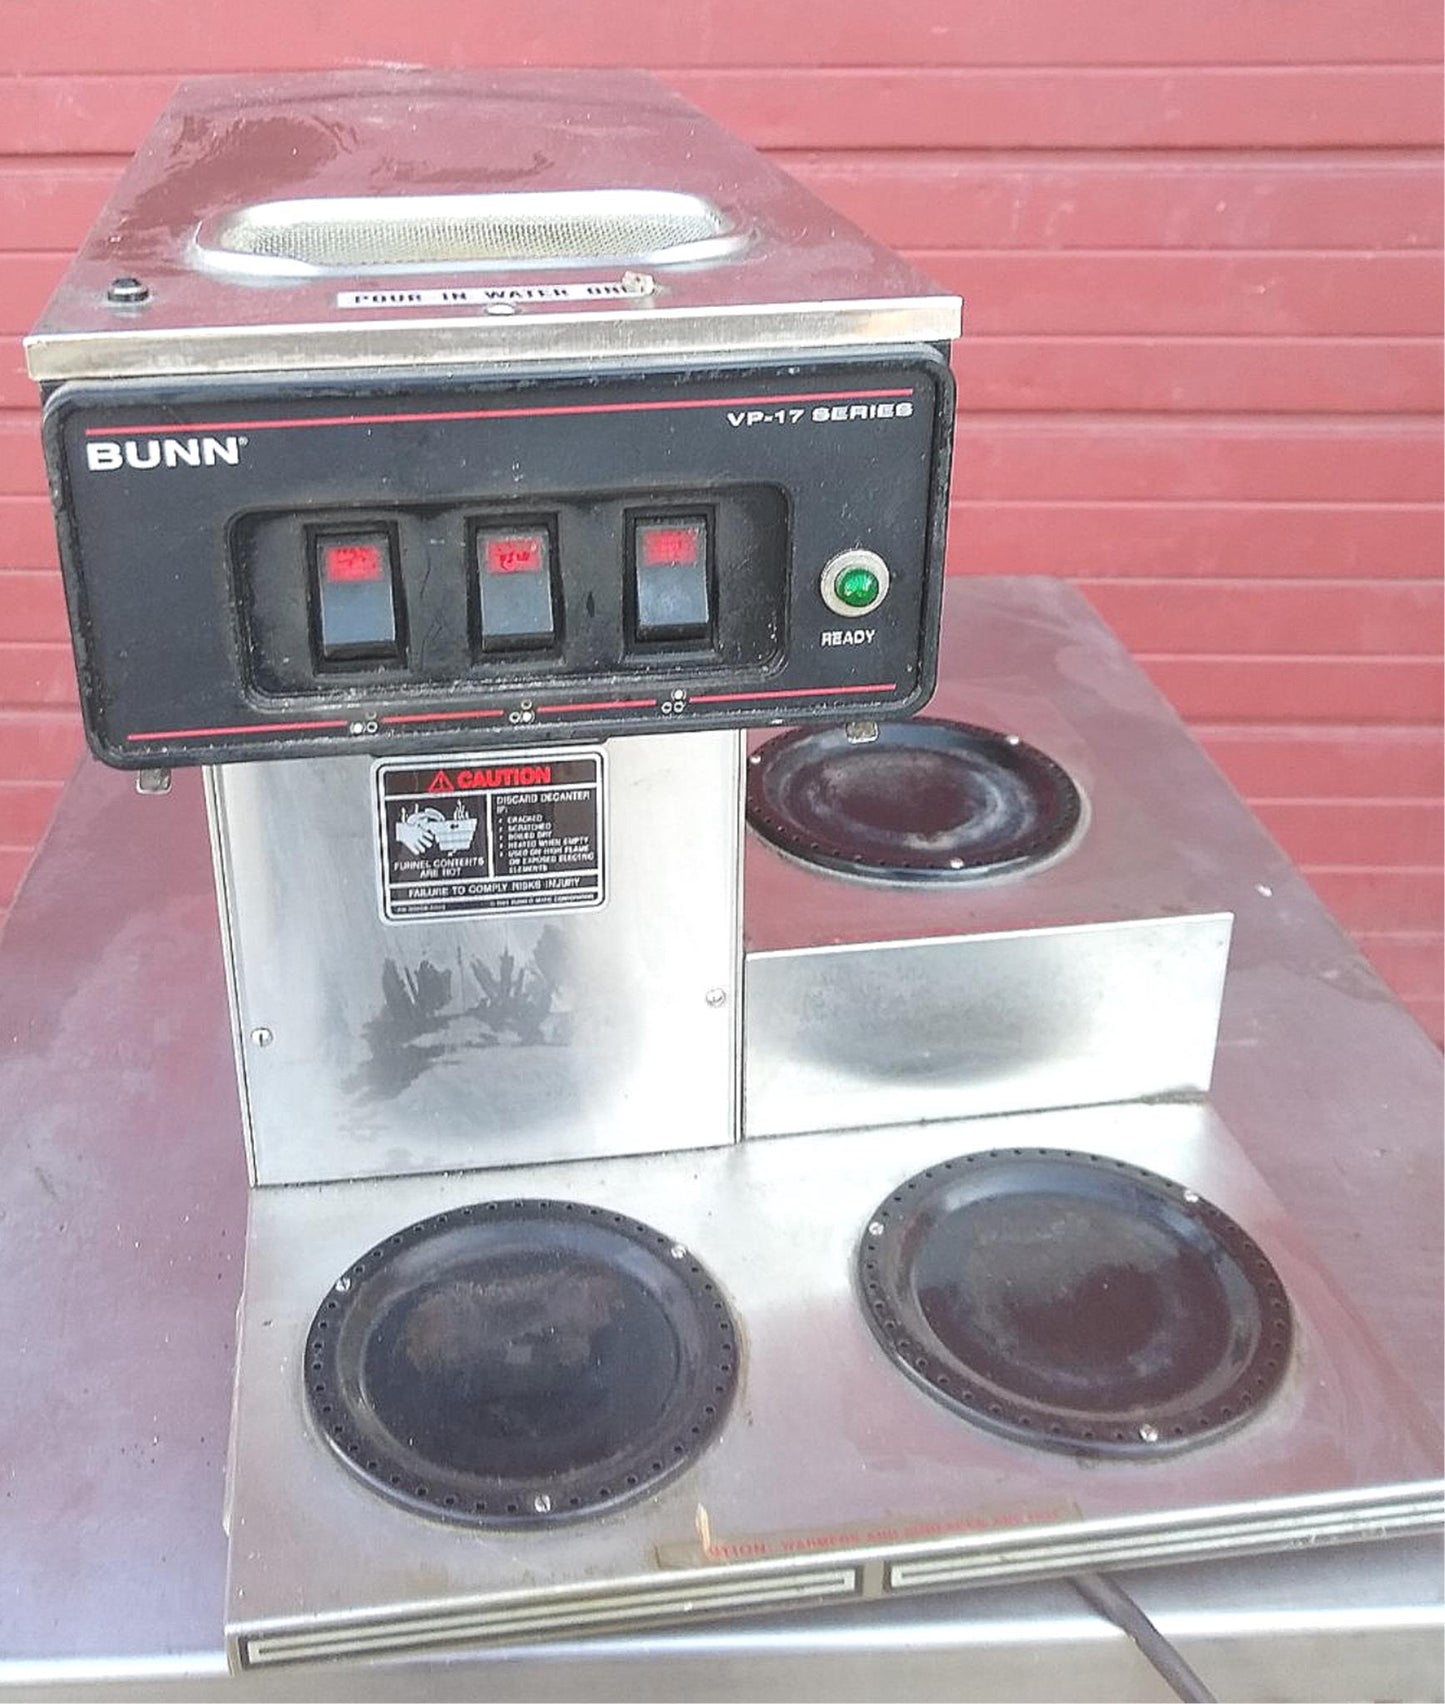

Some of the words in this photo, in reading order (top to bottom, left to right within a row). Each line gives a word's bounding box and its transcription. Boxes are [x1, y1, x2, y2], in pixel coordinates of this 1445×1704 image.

[355, 294, 422, 304] POUR
[443, 292, 467, 301] IN
[484, 287, 570, 299] WATER
[727, 409, 804, 427] VP-17
[812, 402, 914, 422] SERIES
[821, 629, 876, 646] READY
[457, 766, 552, 789] CAUTION
[496, 793, 538, 805] DISCARD
[540, 790, 590, 803] DECANTER
[394, 860, 432, 871] FUNNEL
[433, 857, 485, 869] CONTENTS
[420, 868, 439, 878] ARE
[442, 867, 462, 877] HOT
[408, 886, 449, 898] FAILURE
[452, 885, 466, 896] TO
[468, 882, 508, 894] COMPLY
[512, 880, 542, 891] RISKS
[545, 877, 581, 889] INJURY
